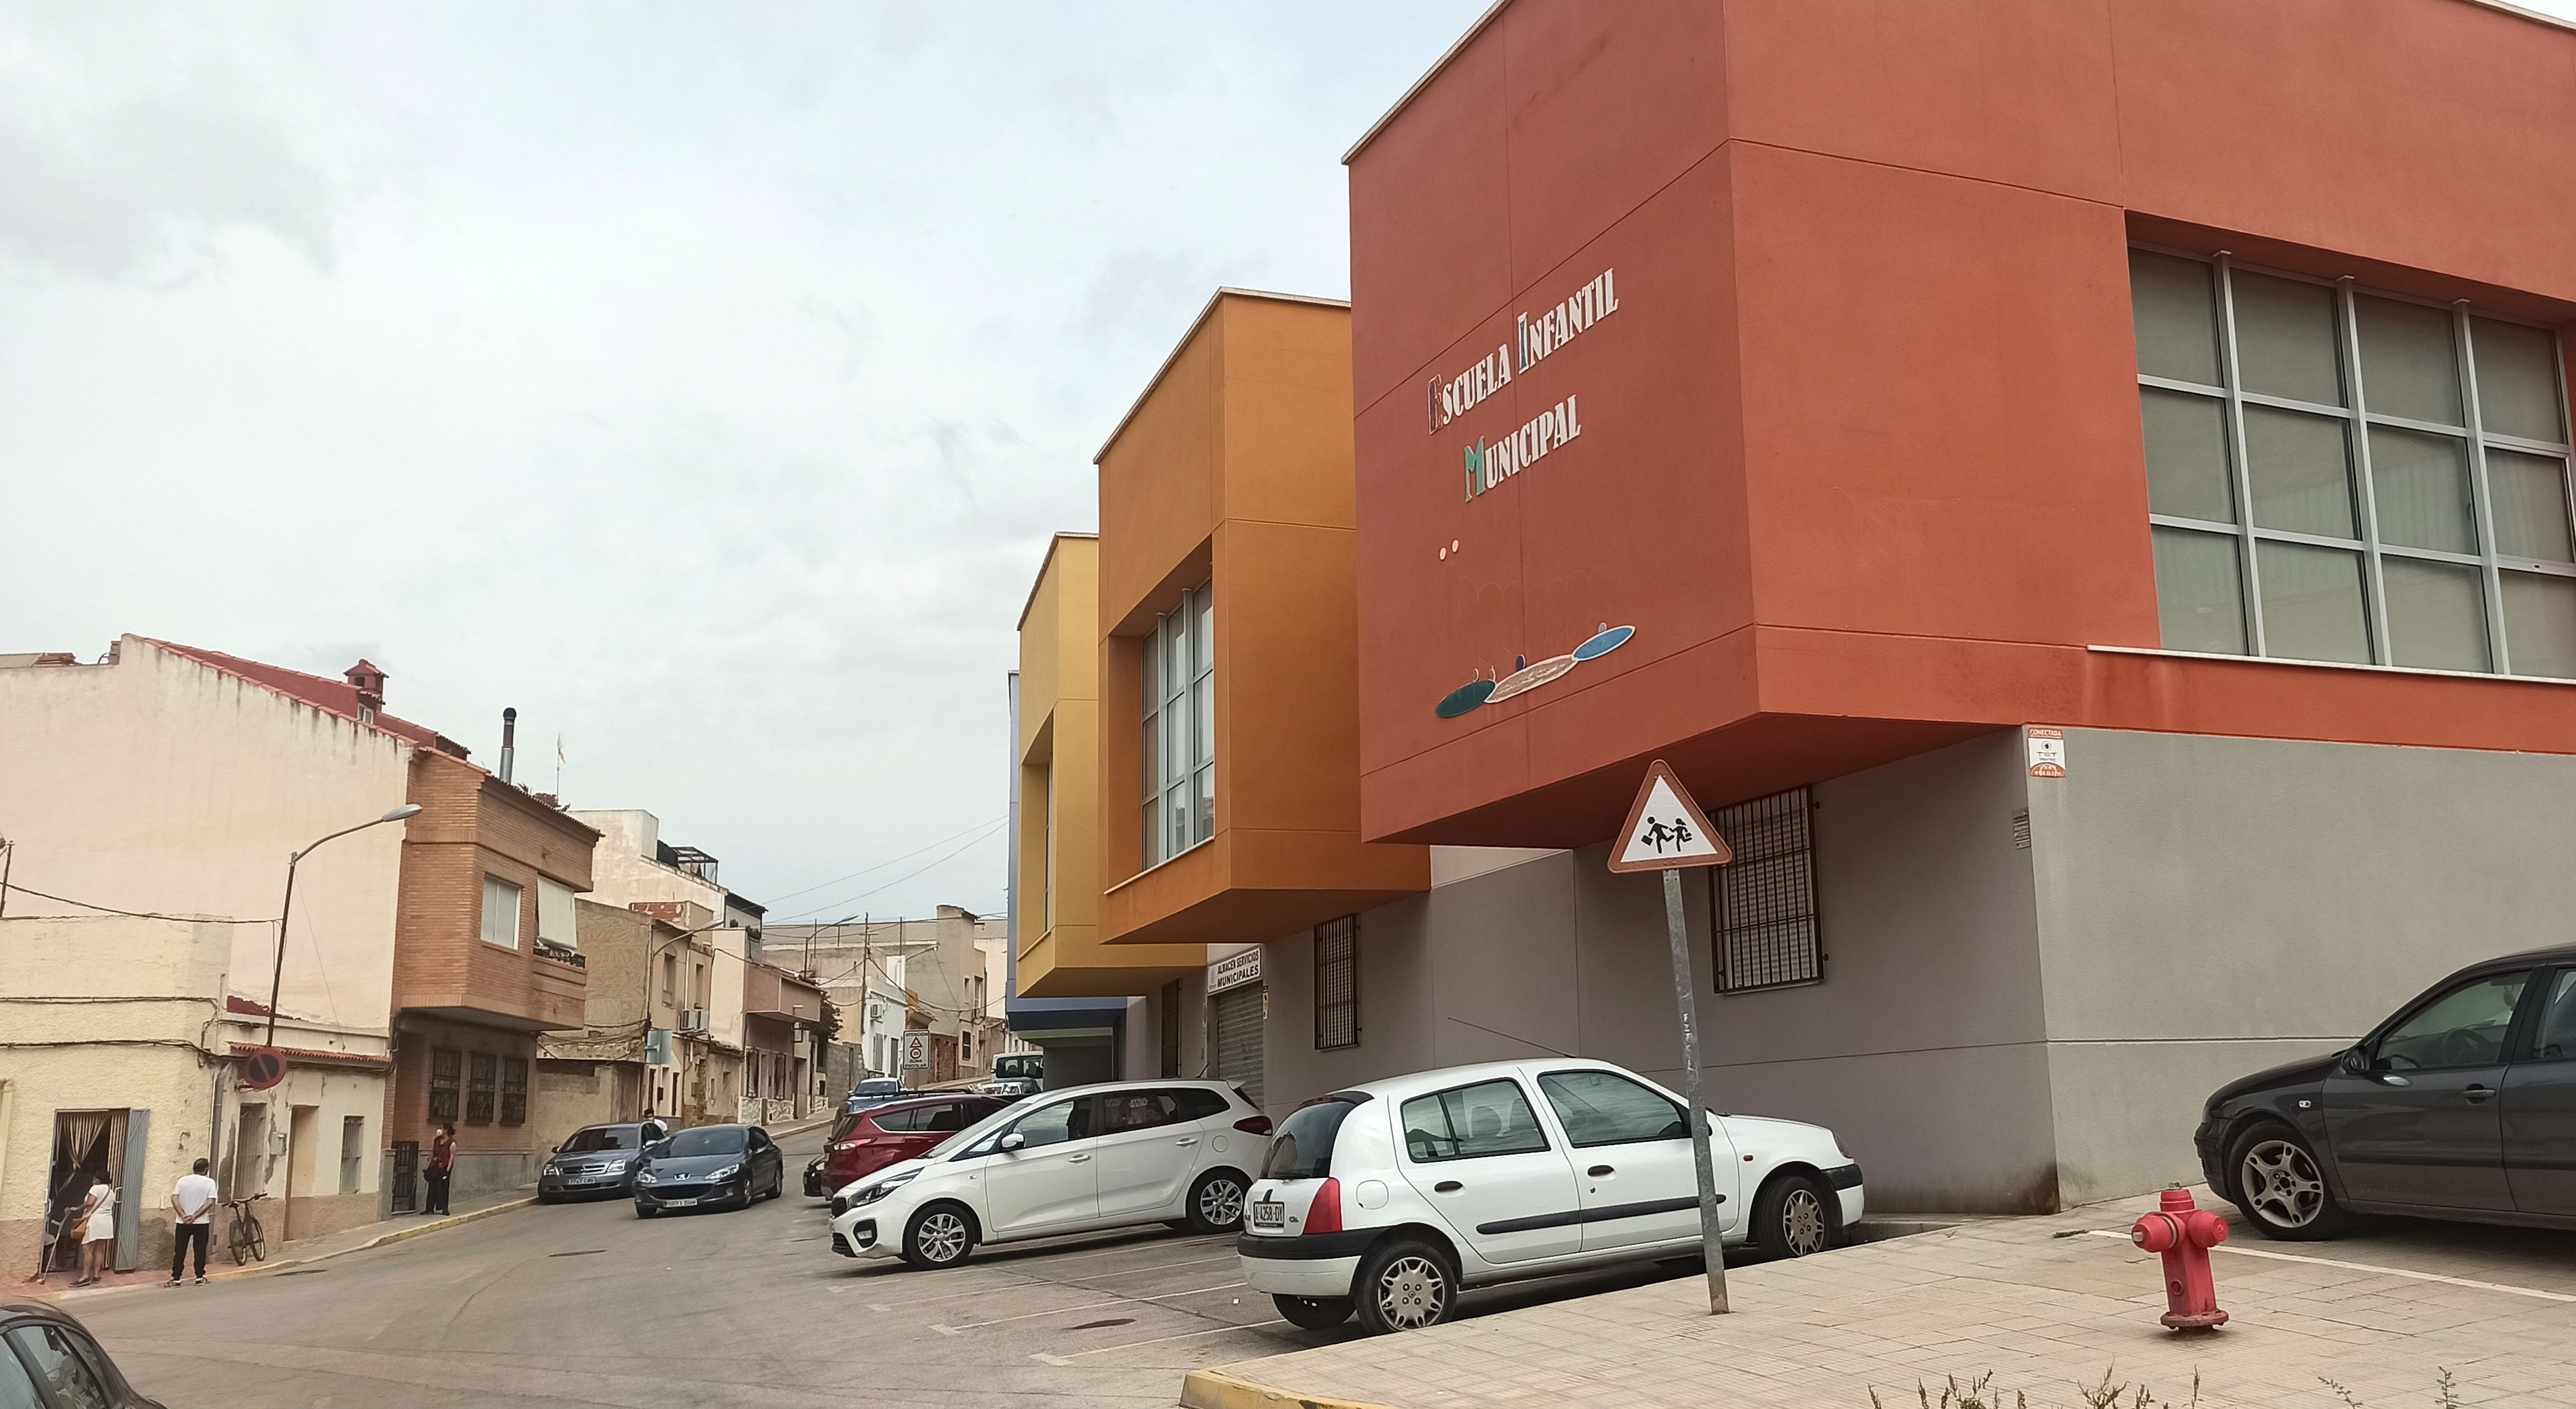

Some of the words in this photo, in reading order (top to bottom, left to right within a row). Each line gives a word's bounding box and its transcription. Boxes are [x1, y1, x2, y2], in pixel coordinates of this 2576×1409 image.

[1428, 343, 1512, 435] ESCUELA
[1517, 268, 1619, 374] INFANTIL
[1464, 394, 1581, 502] MUNICIPAL
[1237, 950, 1259, 968] SERVICIOS
[1217, 965, 1258, 988] MUNICIPALES
[1256, 1206, 1282, 1221] A-4258-DY
